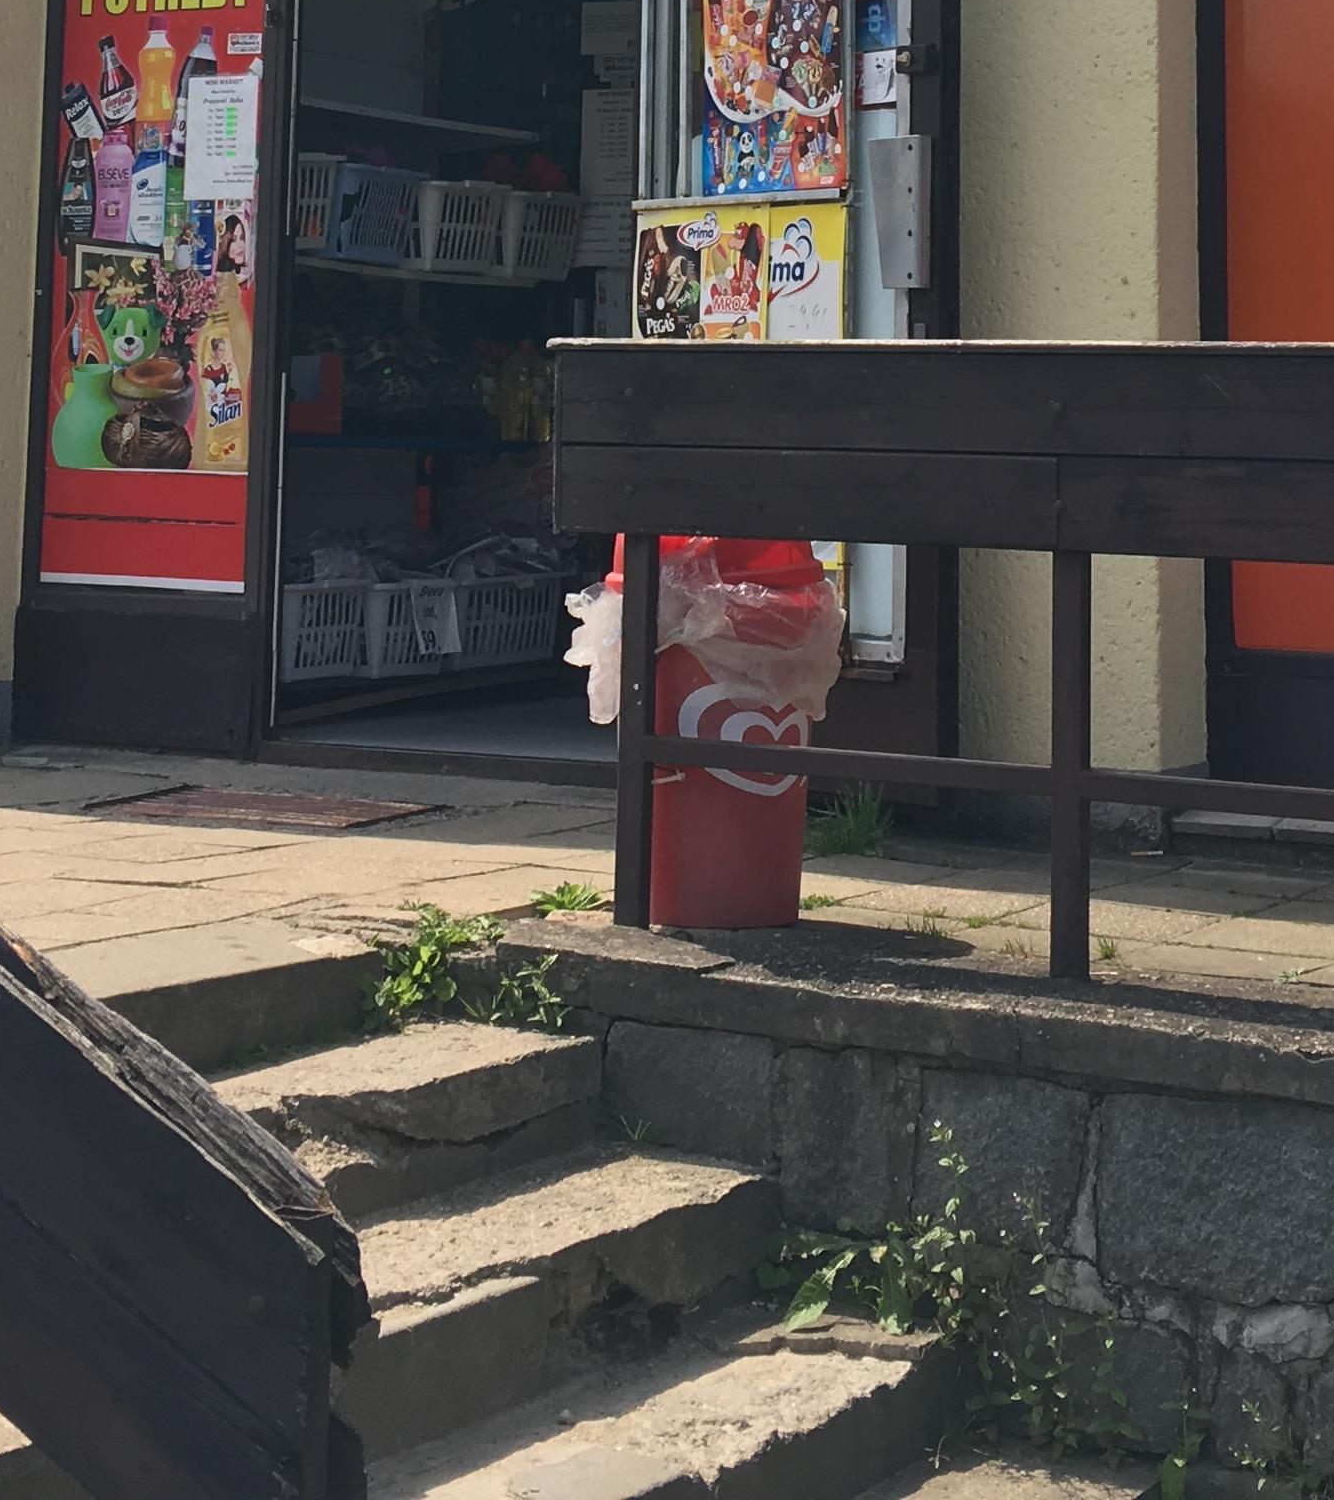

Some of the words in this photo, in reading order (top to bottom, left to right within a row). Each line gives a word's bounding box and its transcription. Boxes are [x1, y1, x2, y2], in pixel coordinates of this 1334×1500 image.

[687, 226, 714, 240] Prima
[712, 293, 750, 312] MROŽ
[209, 400, 242, 428] Silan
